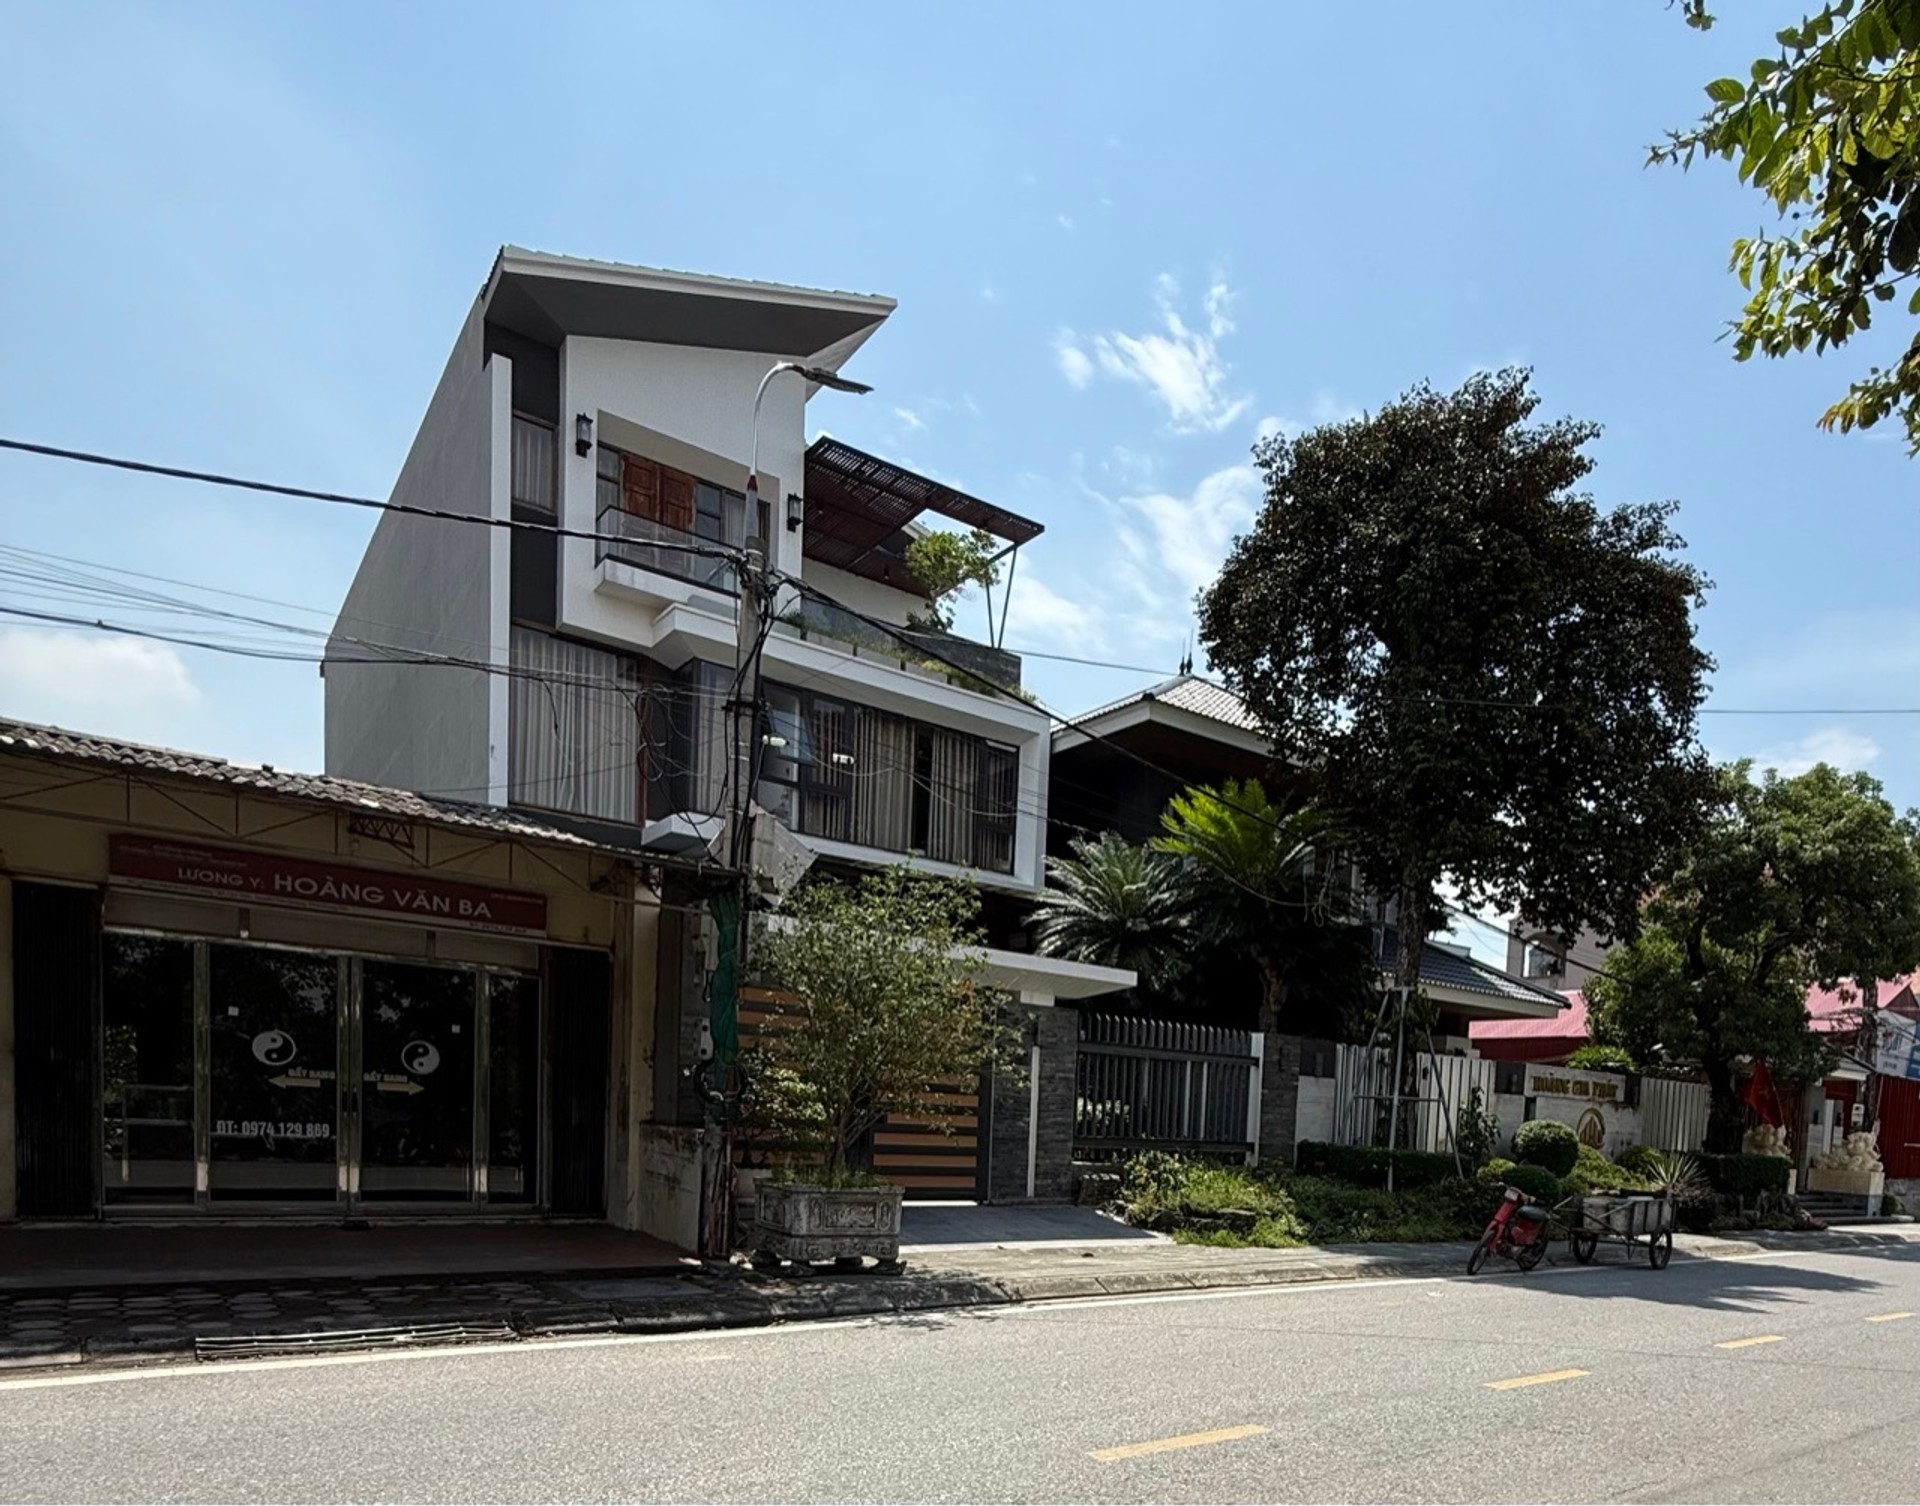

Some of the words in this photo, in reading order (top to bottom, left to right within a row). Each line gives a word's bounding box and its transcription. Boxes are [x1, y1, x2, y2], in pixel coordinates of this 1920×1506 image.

[274, 873, 385, 904] HOÀNG
[392, 888, 451, 913] VĂN
[458, 899, 492, 919] BA
[216, 1120, 239, 1135] ĐT:
[241, 1120, 275, 1136] 0974
[278, 1121, 303, 1137] 129
[305, 1122, 330, 1138] 869
